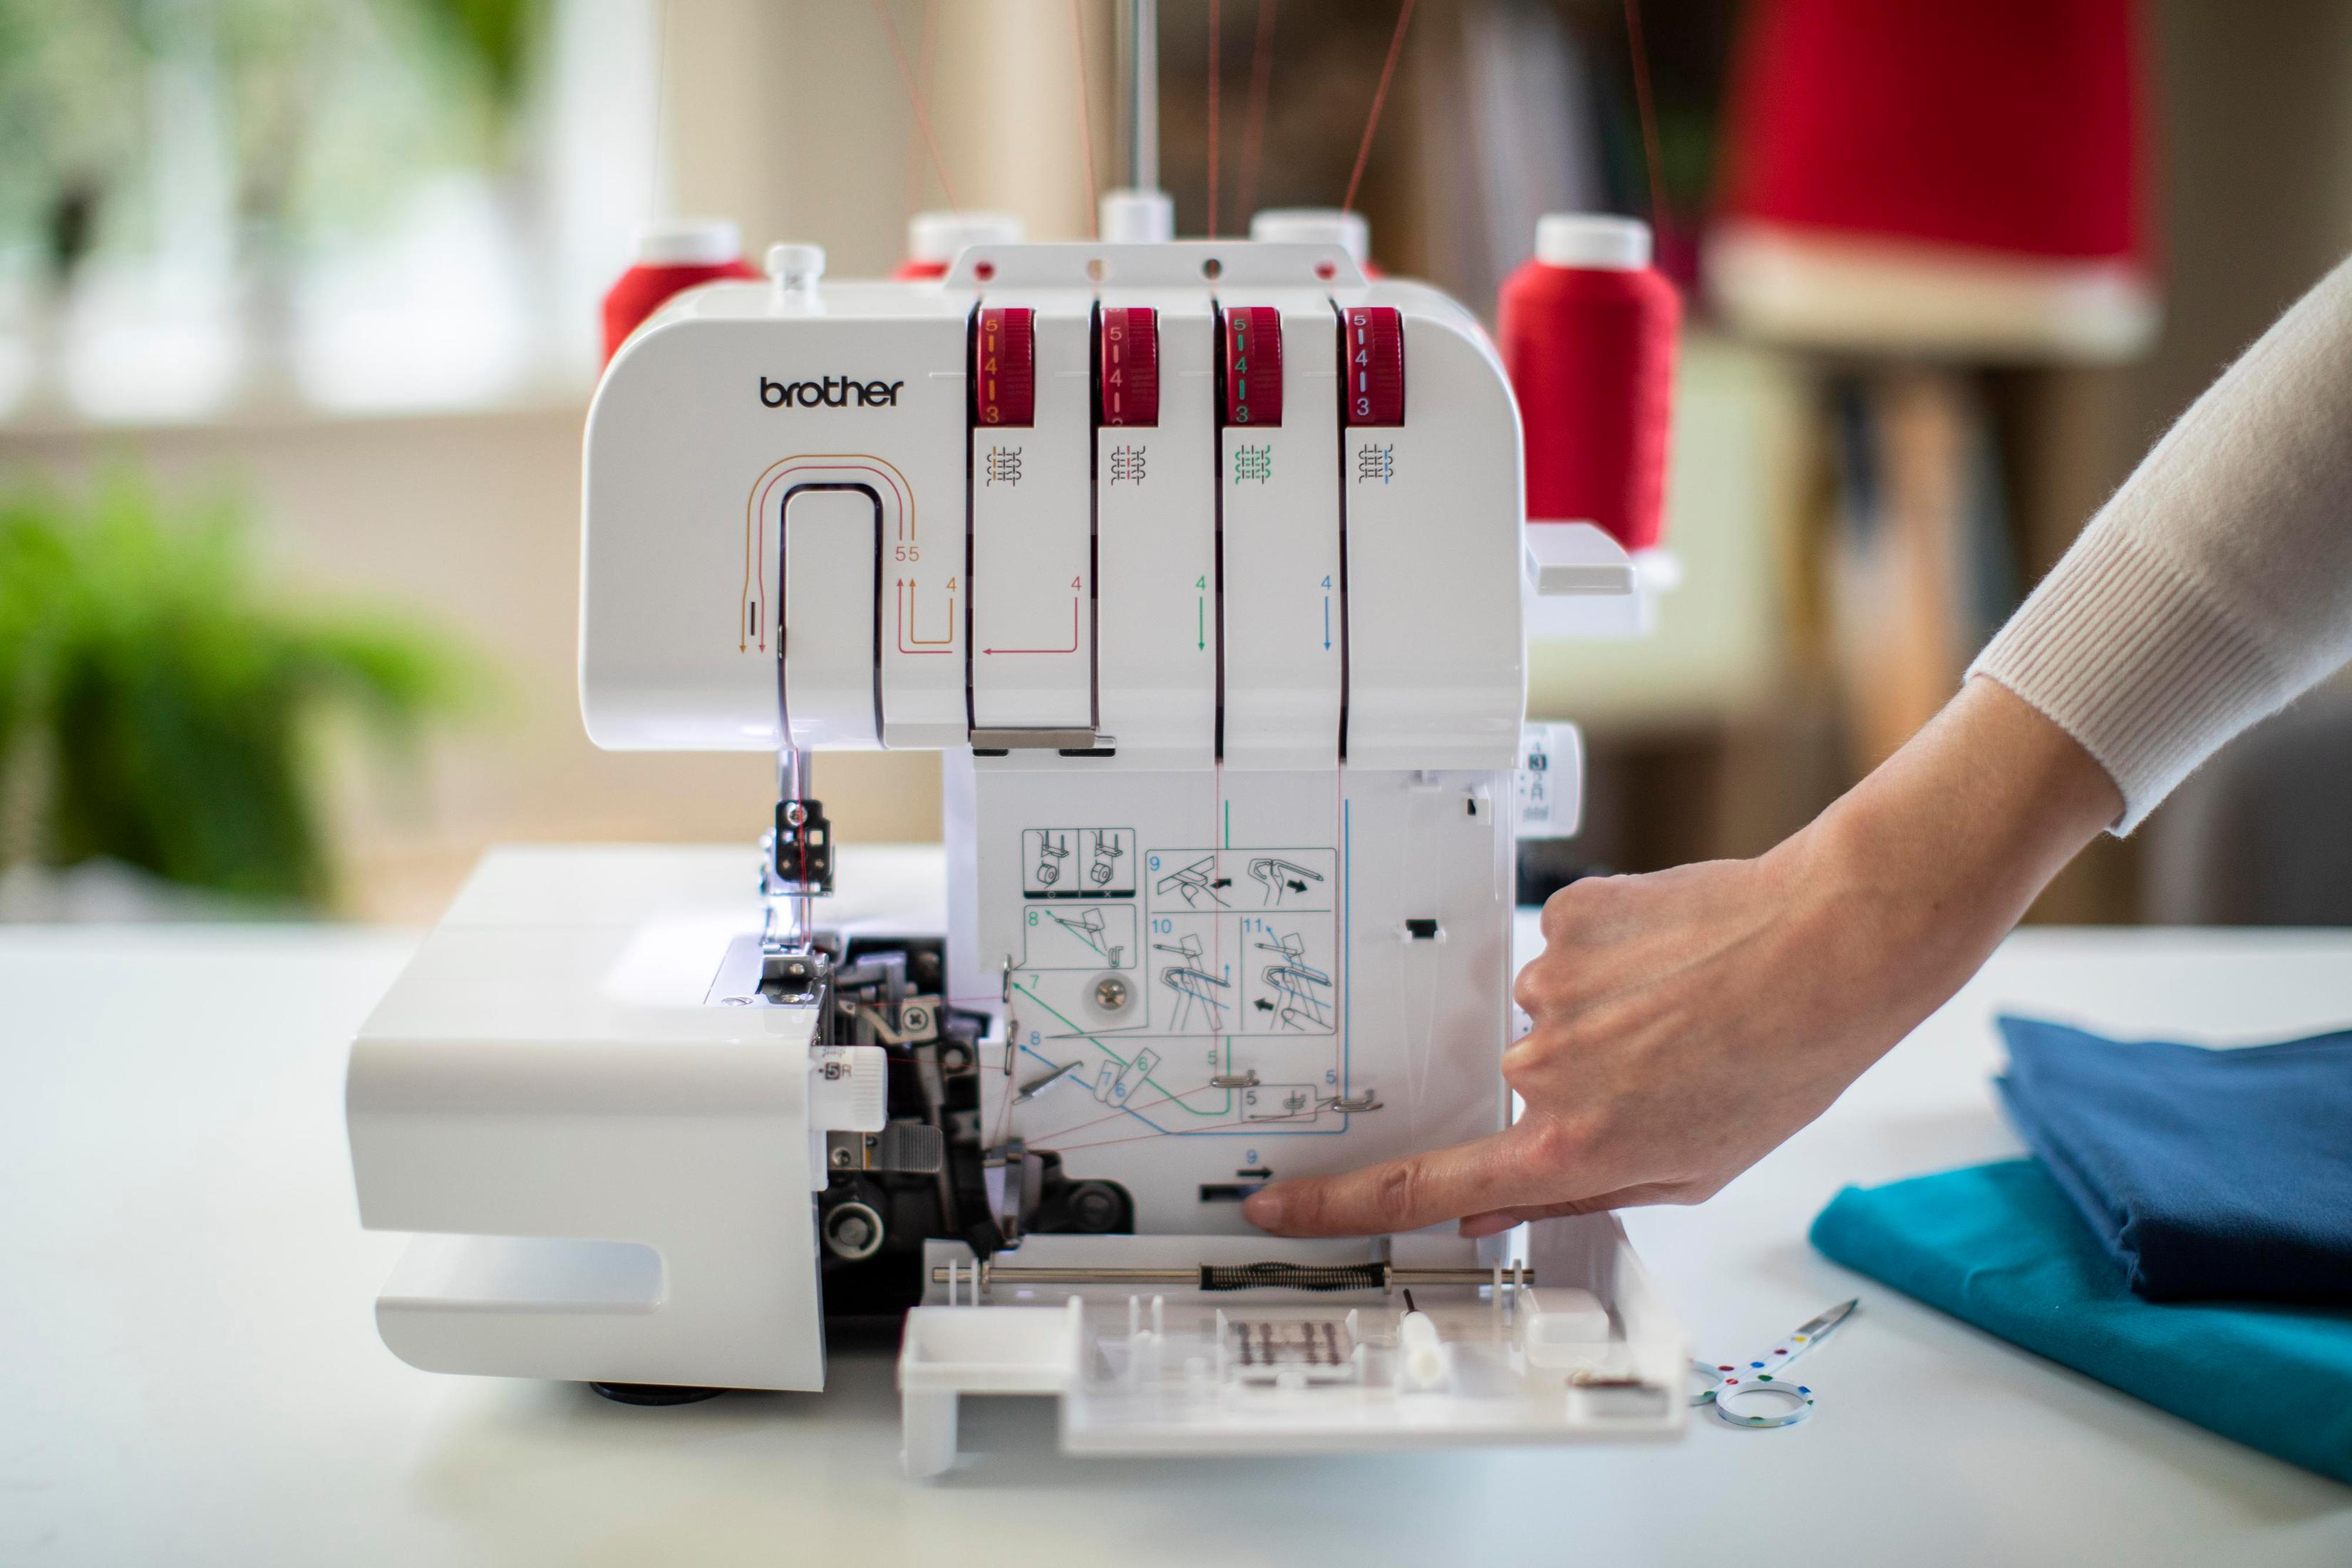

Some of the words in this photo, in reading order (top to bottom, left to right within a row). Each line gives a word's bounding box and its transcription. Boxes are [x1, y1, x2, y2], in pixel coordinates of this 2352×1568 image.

[986, 320, 998, 331] 5
[1234, 319, 1246, 330] 5
[1354, 315, 1366, 326] 5
[1110, 326, 1122, 341] 5
[1356, 349, 1368, 366] 4
[985, 358, 998, 375] 4
[1234, 357, 1247, 374] 4
[1109, 369, 1123, 387] 4
[760, 376, 904, 408] brother
[1236, 406, 1248, 423] 3
[1356, 398, 1369, 416] 3
[986, 407, 998, 423] 3
[946, 577, 957, 592] 4
[1071, 576, 1081, 591] 4
[1196, 575, 1207, 590] 4
[1321, 575, 1331, 590] 4
[1149, 856, 1160, 871] 9
[1028, 912, 1038, 927] 8
[1151, 918, 1172, 934] 10
[1243, 917, 1262, 933] 11
[1029, 974, 1039, 989] 7
[1030, 1031, 1041, 1046] 8
[1207, 1051, 1217, 1066] 5
[1326, 1070, 1336, 1084] 5
[1115, 1083, 1125, 1098] 6
[1247, 1090, 1257, 1105] 5
[1247, 1149, 1257, 1165] 9
